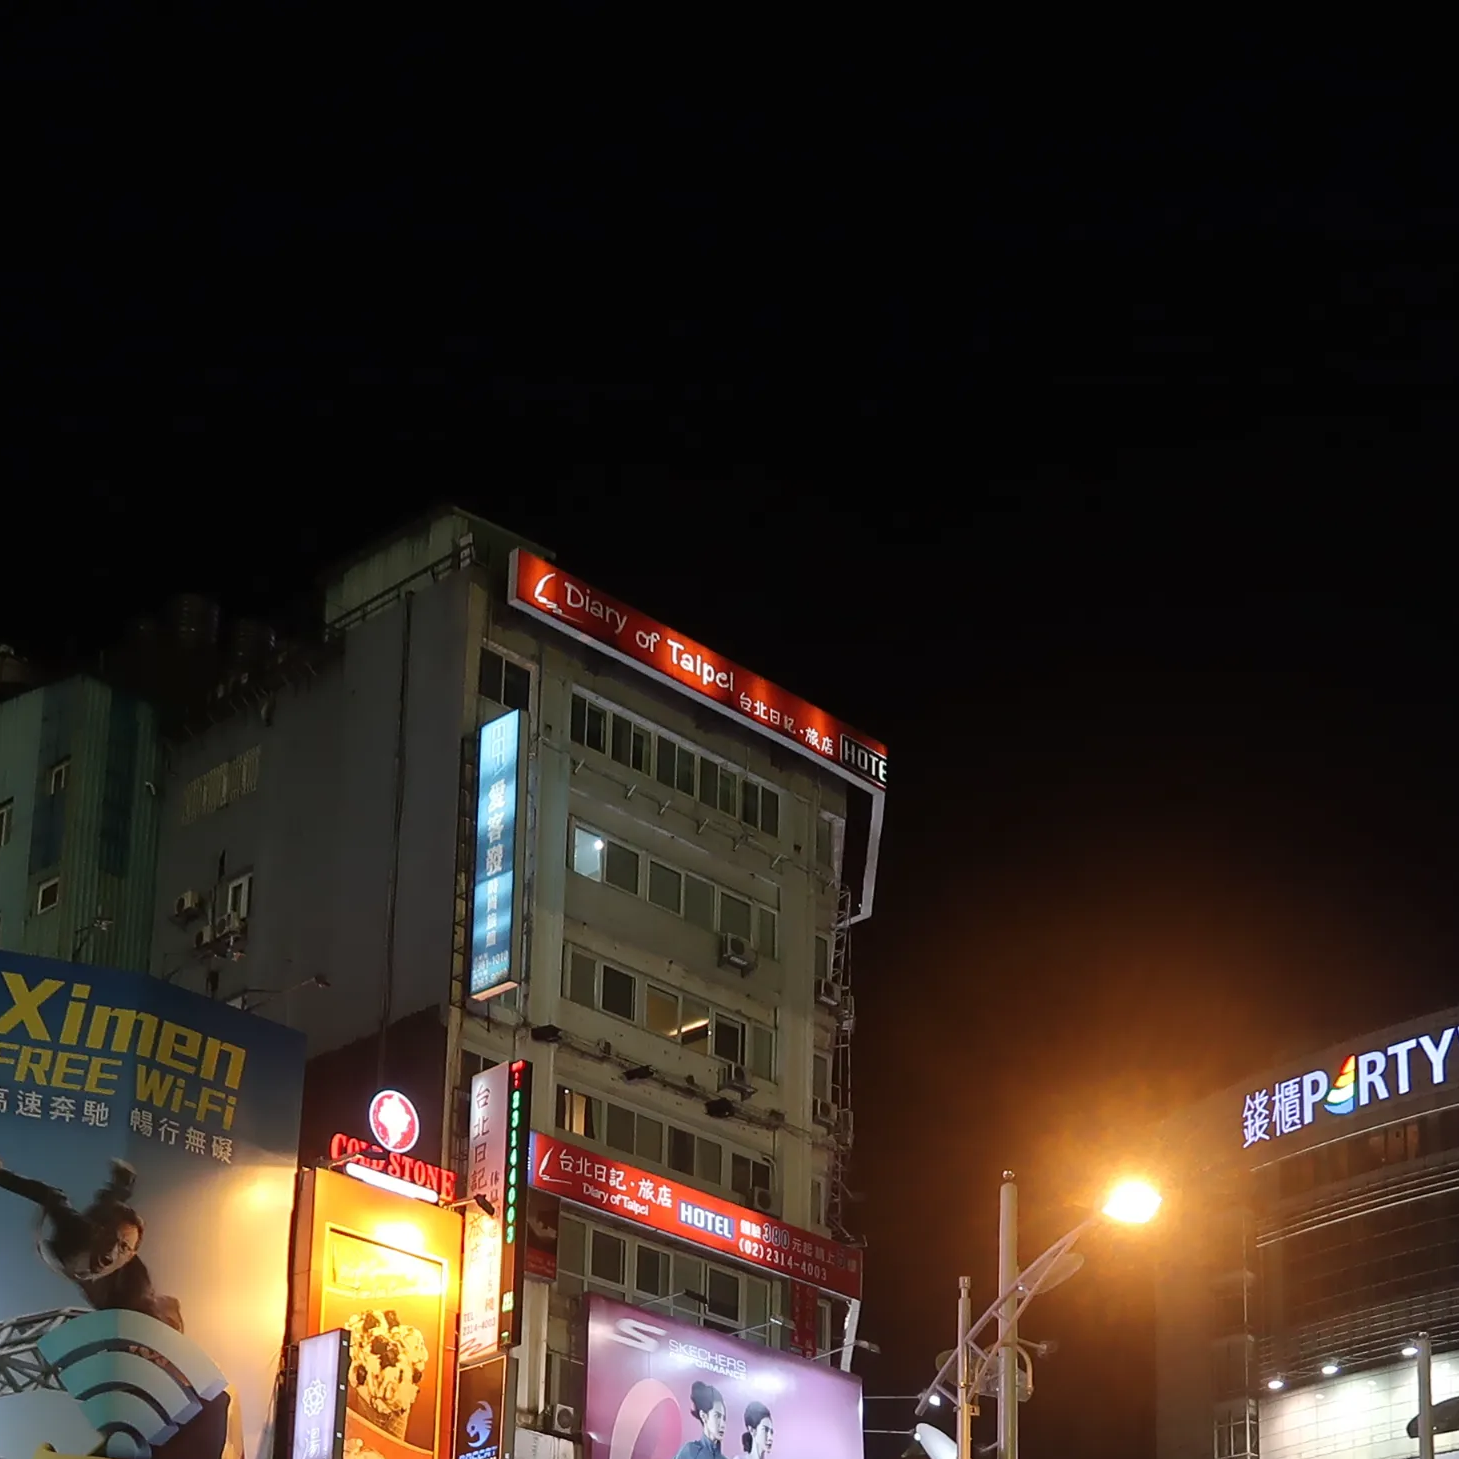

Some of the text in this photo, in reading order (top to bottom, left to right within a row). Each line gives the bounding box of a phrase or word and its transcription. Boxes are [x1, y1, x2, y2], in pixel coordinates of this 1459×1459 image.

[564, 582, 734, 692] Diary of Taipei
[136, 1063, 238, 1131] Wi-Fi
[1242, 1077, 1303, 1150] 錢櫃
[130, 1107, 234, 1166] 暢行無礙
[388, 1152, 457, 1203] STONE
[582, 1181, 609, 1204] Diary
[610, 1192, 622, 1209] of
[680, 1201, 734, 1240] HOTEL
[668, 1338, 748, 1374] SKECHERS
